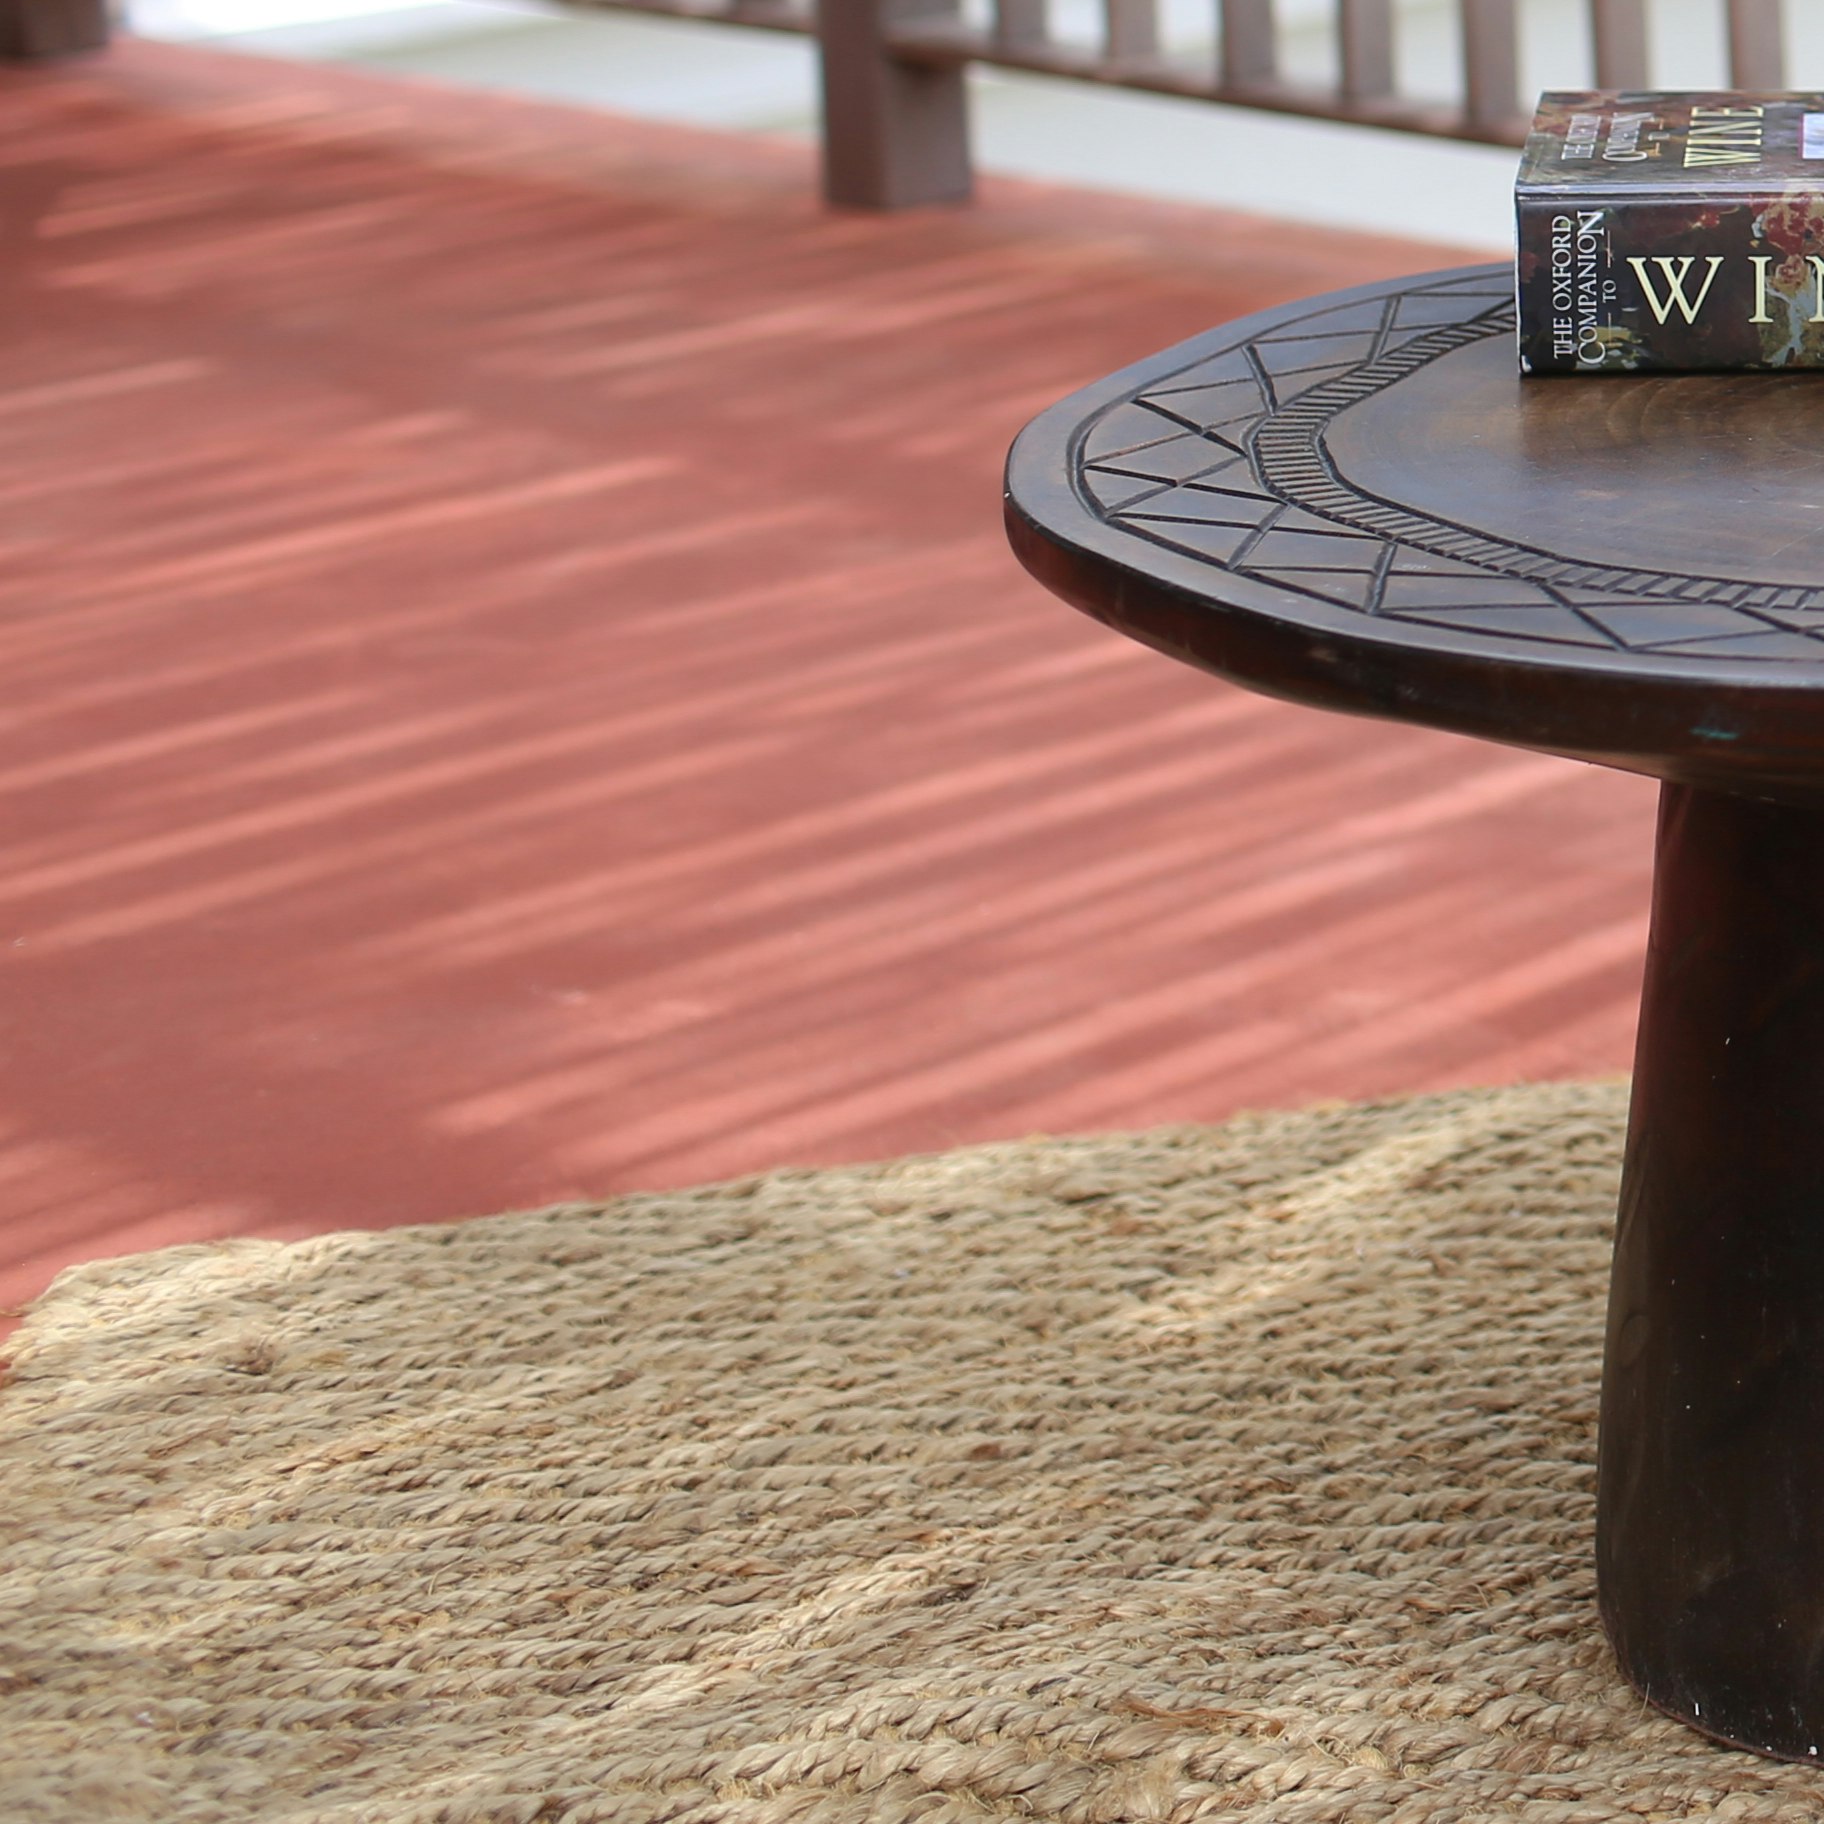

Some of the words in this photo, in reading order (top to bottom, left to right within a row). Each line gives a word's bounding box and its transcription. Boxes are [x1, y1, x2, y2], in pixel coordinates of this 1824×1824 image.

[1683, 105, 1764, 168] WINE
[1551, 215, 1573, 312] OXFORD
[1577, 210, 1606, 366] COMPANION
[1602, 282, 1617, 303] TO
[1553, 315, 1574, 359] THE
